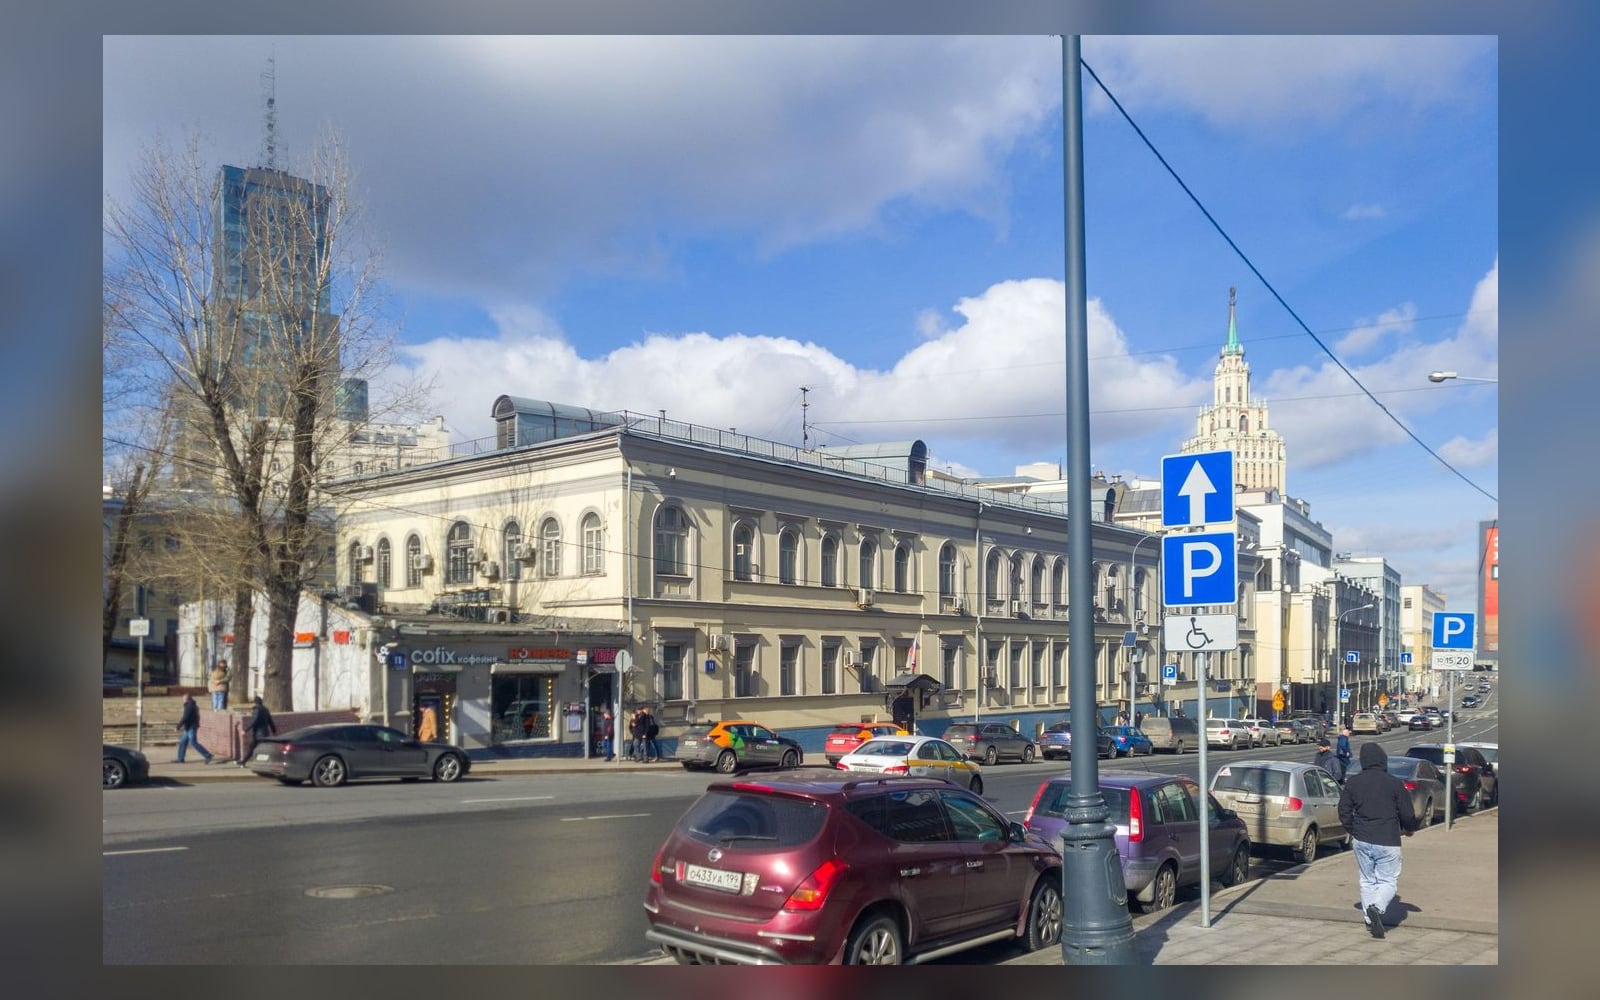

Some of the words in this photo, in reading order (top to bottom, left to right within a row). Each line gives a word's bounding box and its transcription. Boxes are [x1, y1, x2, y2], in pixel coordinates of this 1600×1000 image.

[1183, 541, 1222, 597] P
[1443, 616, 1465, 644] P
[411, 646, 455, 663] cofix
[1445, 656, 1454, 664] 15
[1456, 656, 1469, 665] 20
[1166, 667, 1174, 677] P
